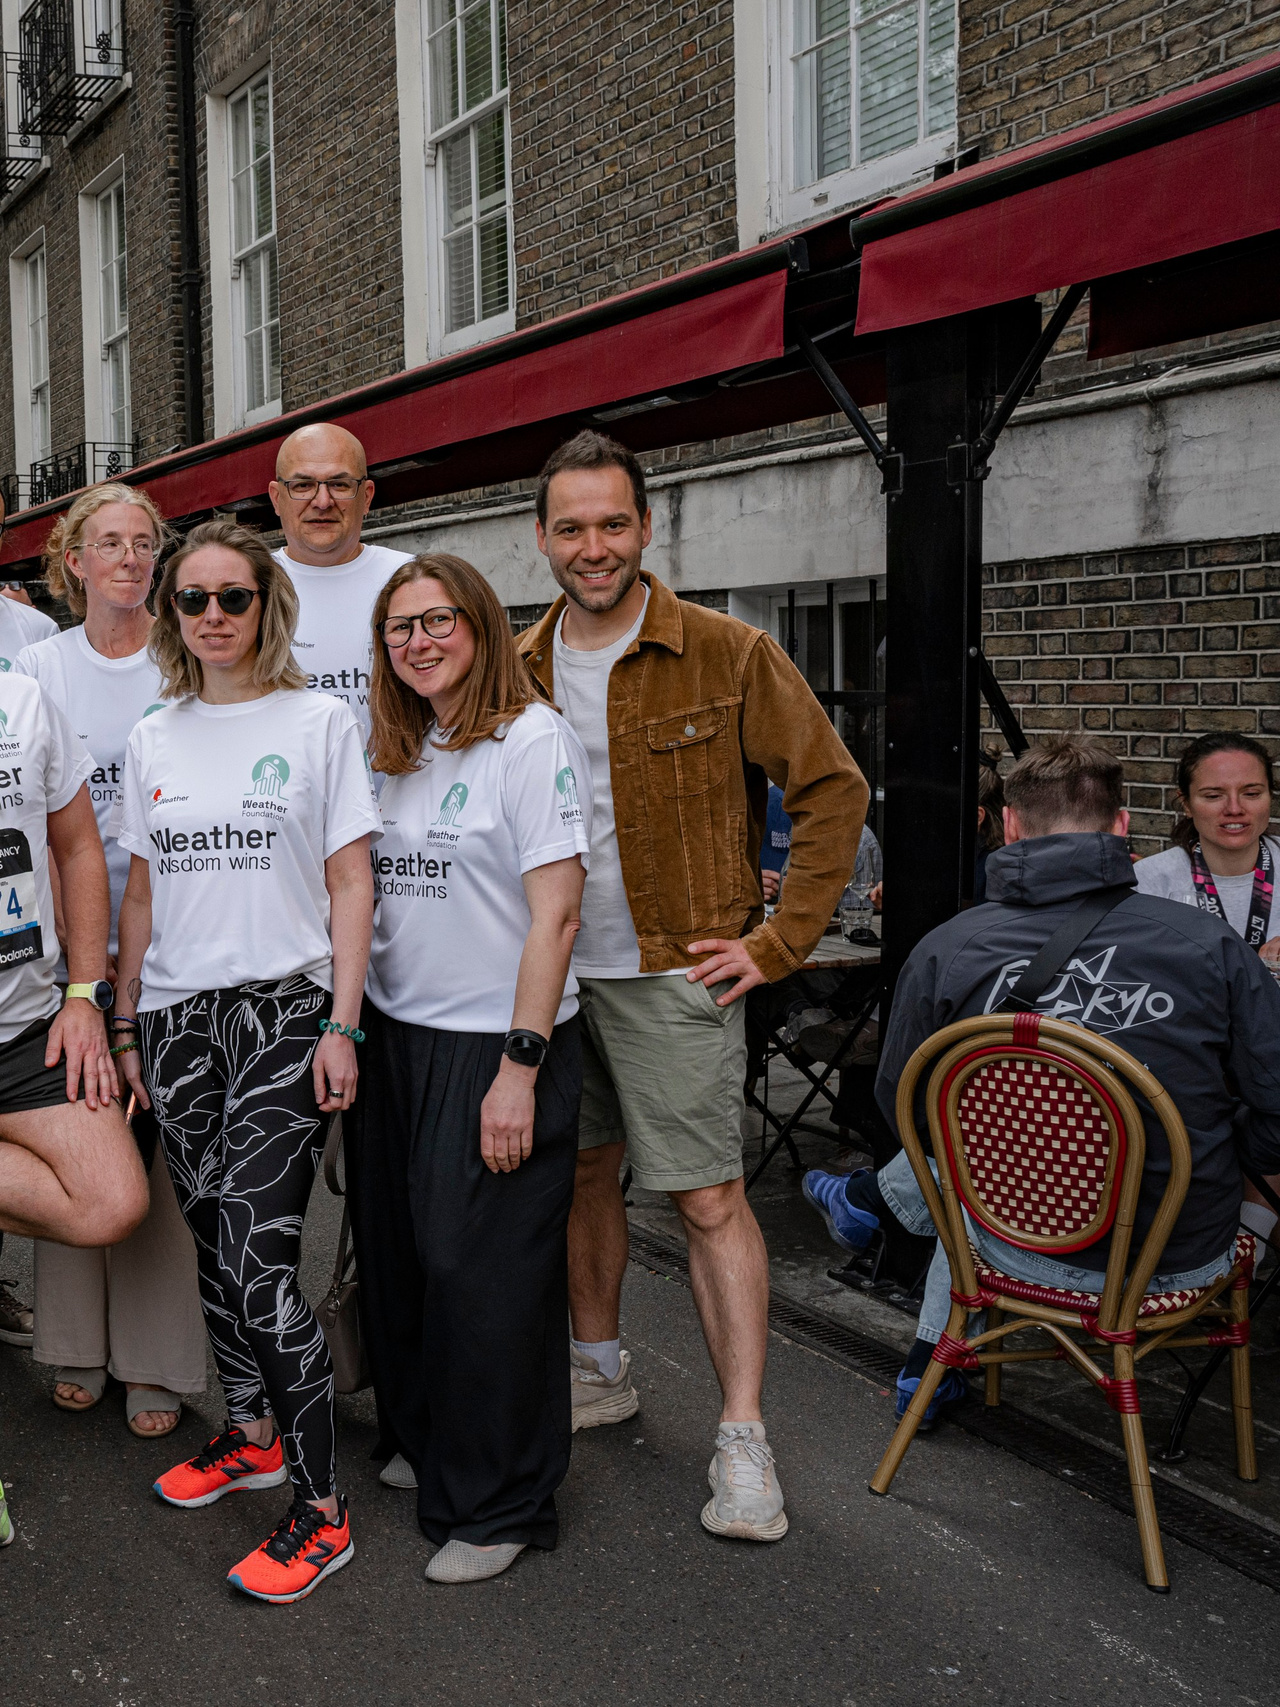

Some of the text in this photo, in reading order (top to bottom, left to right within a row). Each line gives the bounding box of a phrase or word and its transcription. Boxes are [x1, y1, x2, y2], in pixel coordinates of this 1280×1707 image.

[305, 668, 370, 689] eath
[150, 795, 189, 811] Weather
[242, 800, 288, 814] Weather
[241, 810, 285, 822] Foundation
[149, 823, 277, 854] Weather
[427, 829, 460, 841] Weather
[426, 840, 457, 850] Foundation
[157, 852, 271, 875] Wsdom wins
[0, 946, 34, 964] balance
